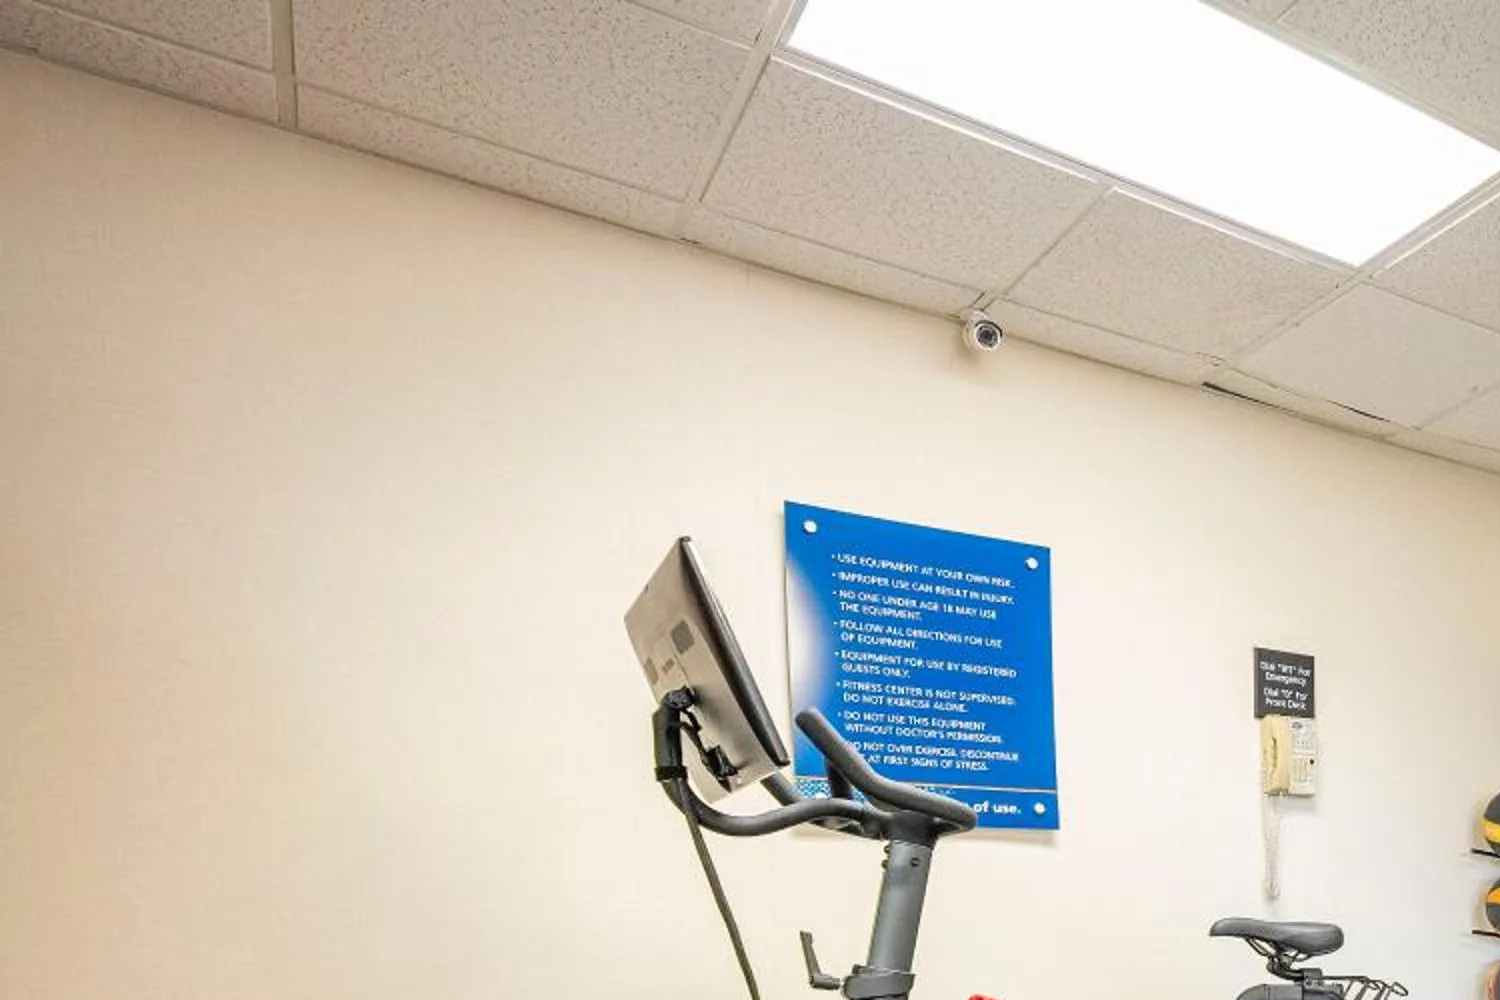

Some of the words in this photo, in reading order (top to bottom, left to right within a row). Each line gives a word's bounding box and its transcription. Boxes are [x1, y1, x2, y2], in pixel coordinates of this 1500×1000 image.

[838, 553, 858, 565] USE
[860, 556, 919, 573] EQUIPMENT
[921, 566, 934, 576] AT
[936, 568, 963, 580] YOUR
[966, 572, 989, 584] OWN
[838, 571, 889, 587] IMPROPER
[892, 579, 910, 590] USE
[912, 582, 934, 593] CAN
[839, 589, 856, 599] NO
[858, 591, 880, 602] ONE
[882, 595, 917, 608] UNDER
[840, 601, 860, 613] THE
[840, 619, 884, 633] FOLLOW
[886, 625, 905, 637] ALL
[906, 627, 962, 644] DIRECTIONS
[964, 634, 983, 647] FOR
[985, 637, 1003, 649] USE
[841, 631, 855, 642] OF
[841, 649, 902, 665] EQUIPMENT
[904, 656, 924, 668] FOR
[946, 661, 960, 672] BY
[962, 663, 1017, 678] REGISTERED
[841, 661, 881, 675] GUESTS
[1265, 671, 1307, 688] Emergency
[842, 679, 882, 693] FITNESS
[885, 684, 923, 697] CENTER
[936, 688, 957, 700] NOT
[843, 692, 860, 703] DO
[862, 694, 884, 705] NOT
[843, 709, 861, 721] DO
[863, 711, 885, 723] NOT
[887, 712, 906, 724] USE
[908, 714, 930, 727] THIS
[931, 717, 986, 732] EQUIPMENT
[844, 722, 894, 735] WITHOUT
[863, 741, 885, 752] NOT
[883, 754, 910, 766] FIRST
[911, 757, 939, 769] SIGNS
[940, 758, 953, 769] OF
[973, 799, 990, 814] of
[992, 802, 1021, 816] use.
